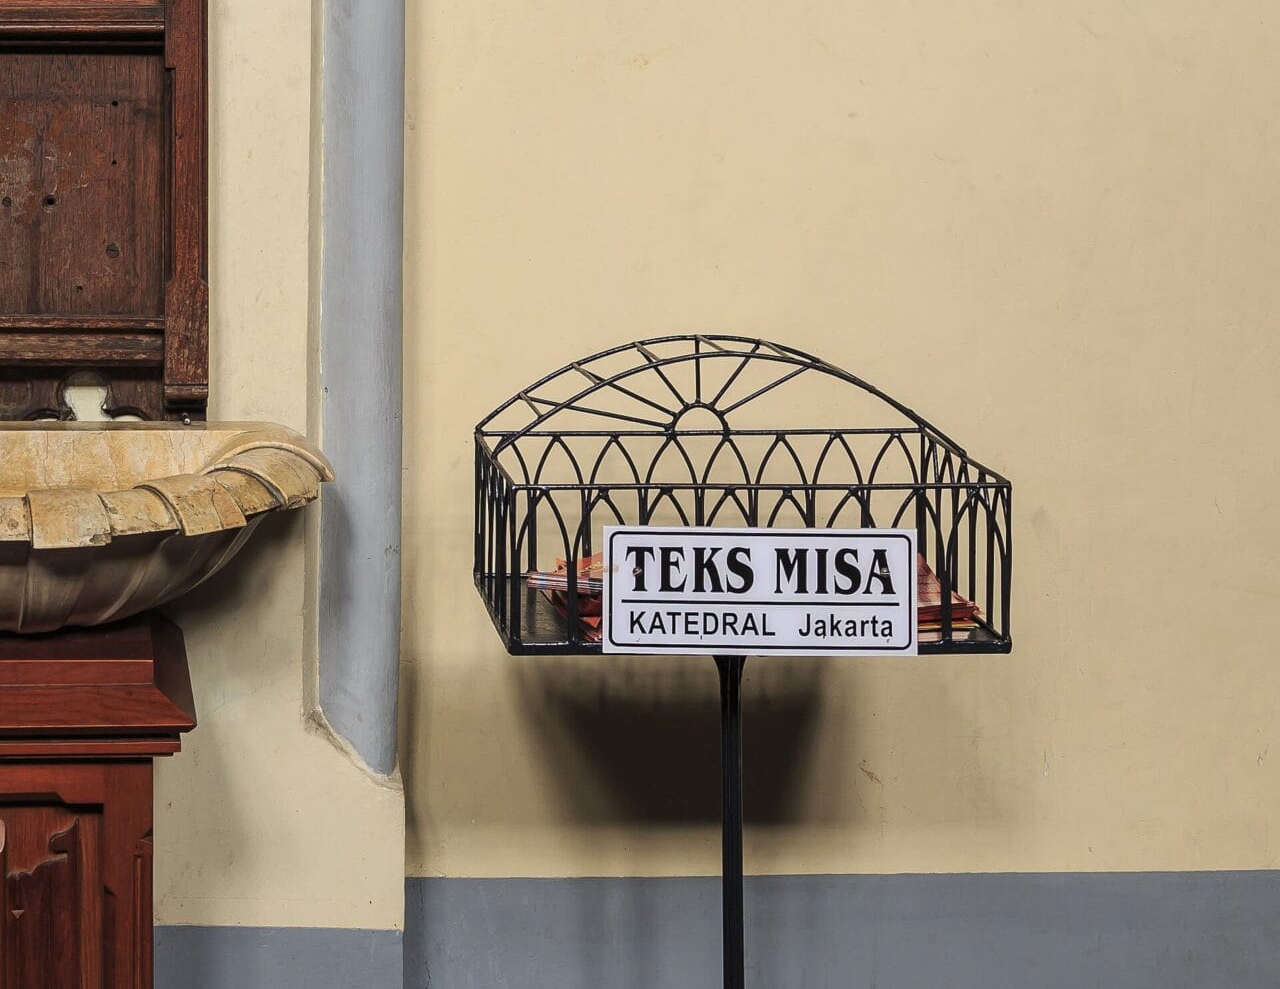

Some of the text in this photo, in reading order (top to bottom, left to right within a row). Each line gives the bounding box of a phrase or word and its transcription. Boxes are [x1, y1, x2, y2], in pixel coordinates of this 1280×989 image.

[626, 546, 754, 595] TEKS
[774, 548, 897, 596] MISA
[630, 611, 893, 639] KATEDRAL Jakarta
